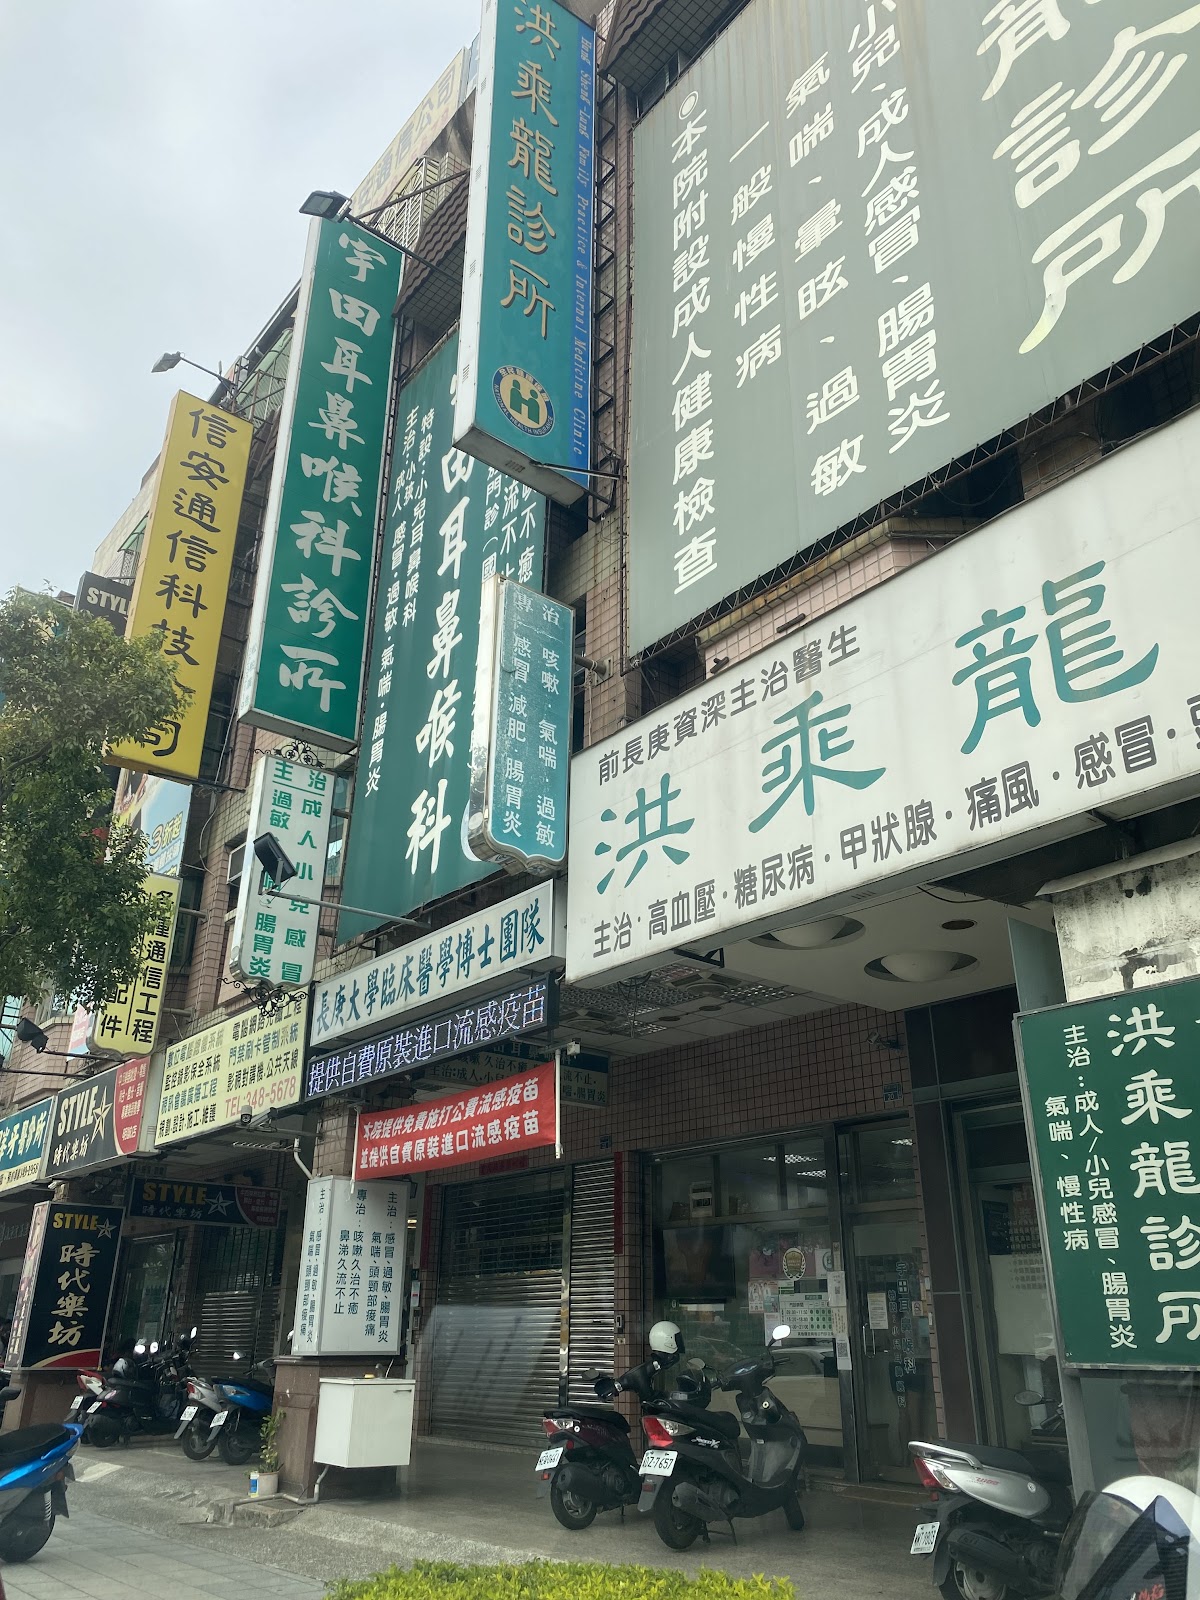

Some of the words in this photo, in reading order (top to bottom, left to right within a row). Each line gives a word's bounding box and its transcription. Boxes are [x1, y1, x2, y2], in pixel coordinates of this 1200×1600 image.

[501, 0, 562, 340] 洪乘龍診所
[576, 144, 590, 188] Family
[576, 194, 589, 255] Practice
[729, 121, 782, 389] 一般慢性病
[575, 274, 588, 334] Internal
[574, 337, 587, 399] Medicine
[279, 232, 387, 713] 宇田耳鼻喉科診所
[573, 408, 586, 455] Clinic
[87, 587, 129, 616] STYL
[140, 407, 237, 757] 信安通信科技司
[405, 372, 475, 875] 田耳鼻喉科
[595, 560, 1159, 895] 洪乘龍
[598, 625, 861, 786] 前長庚資深主治醫生
[273, 760, 327, 792] 主治
[316, 898, 545, 1036] 長庚大學臨床醫學博士團隊
[307, 985, 546, 1097] 提供自費原裝進口流感疫苗
[57, 1085, 99, 1137] STYLE
[53, 1212, 99, 1231] STYLE
[142, 1182, 208, 1205] STYLE
[48, 1242, 101, 1347] 時代樂坊
[333, 1229, 350, 1315] 鼻涕久流不止
